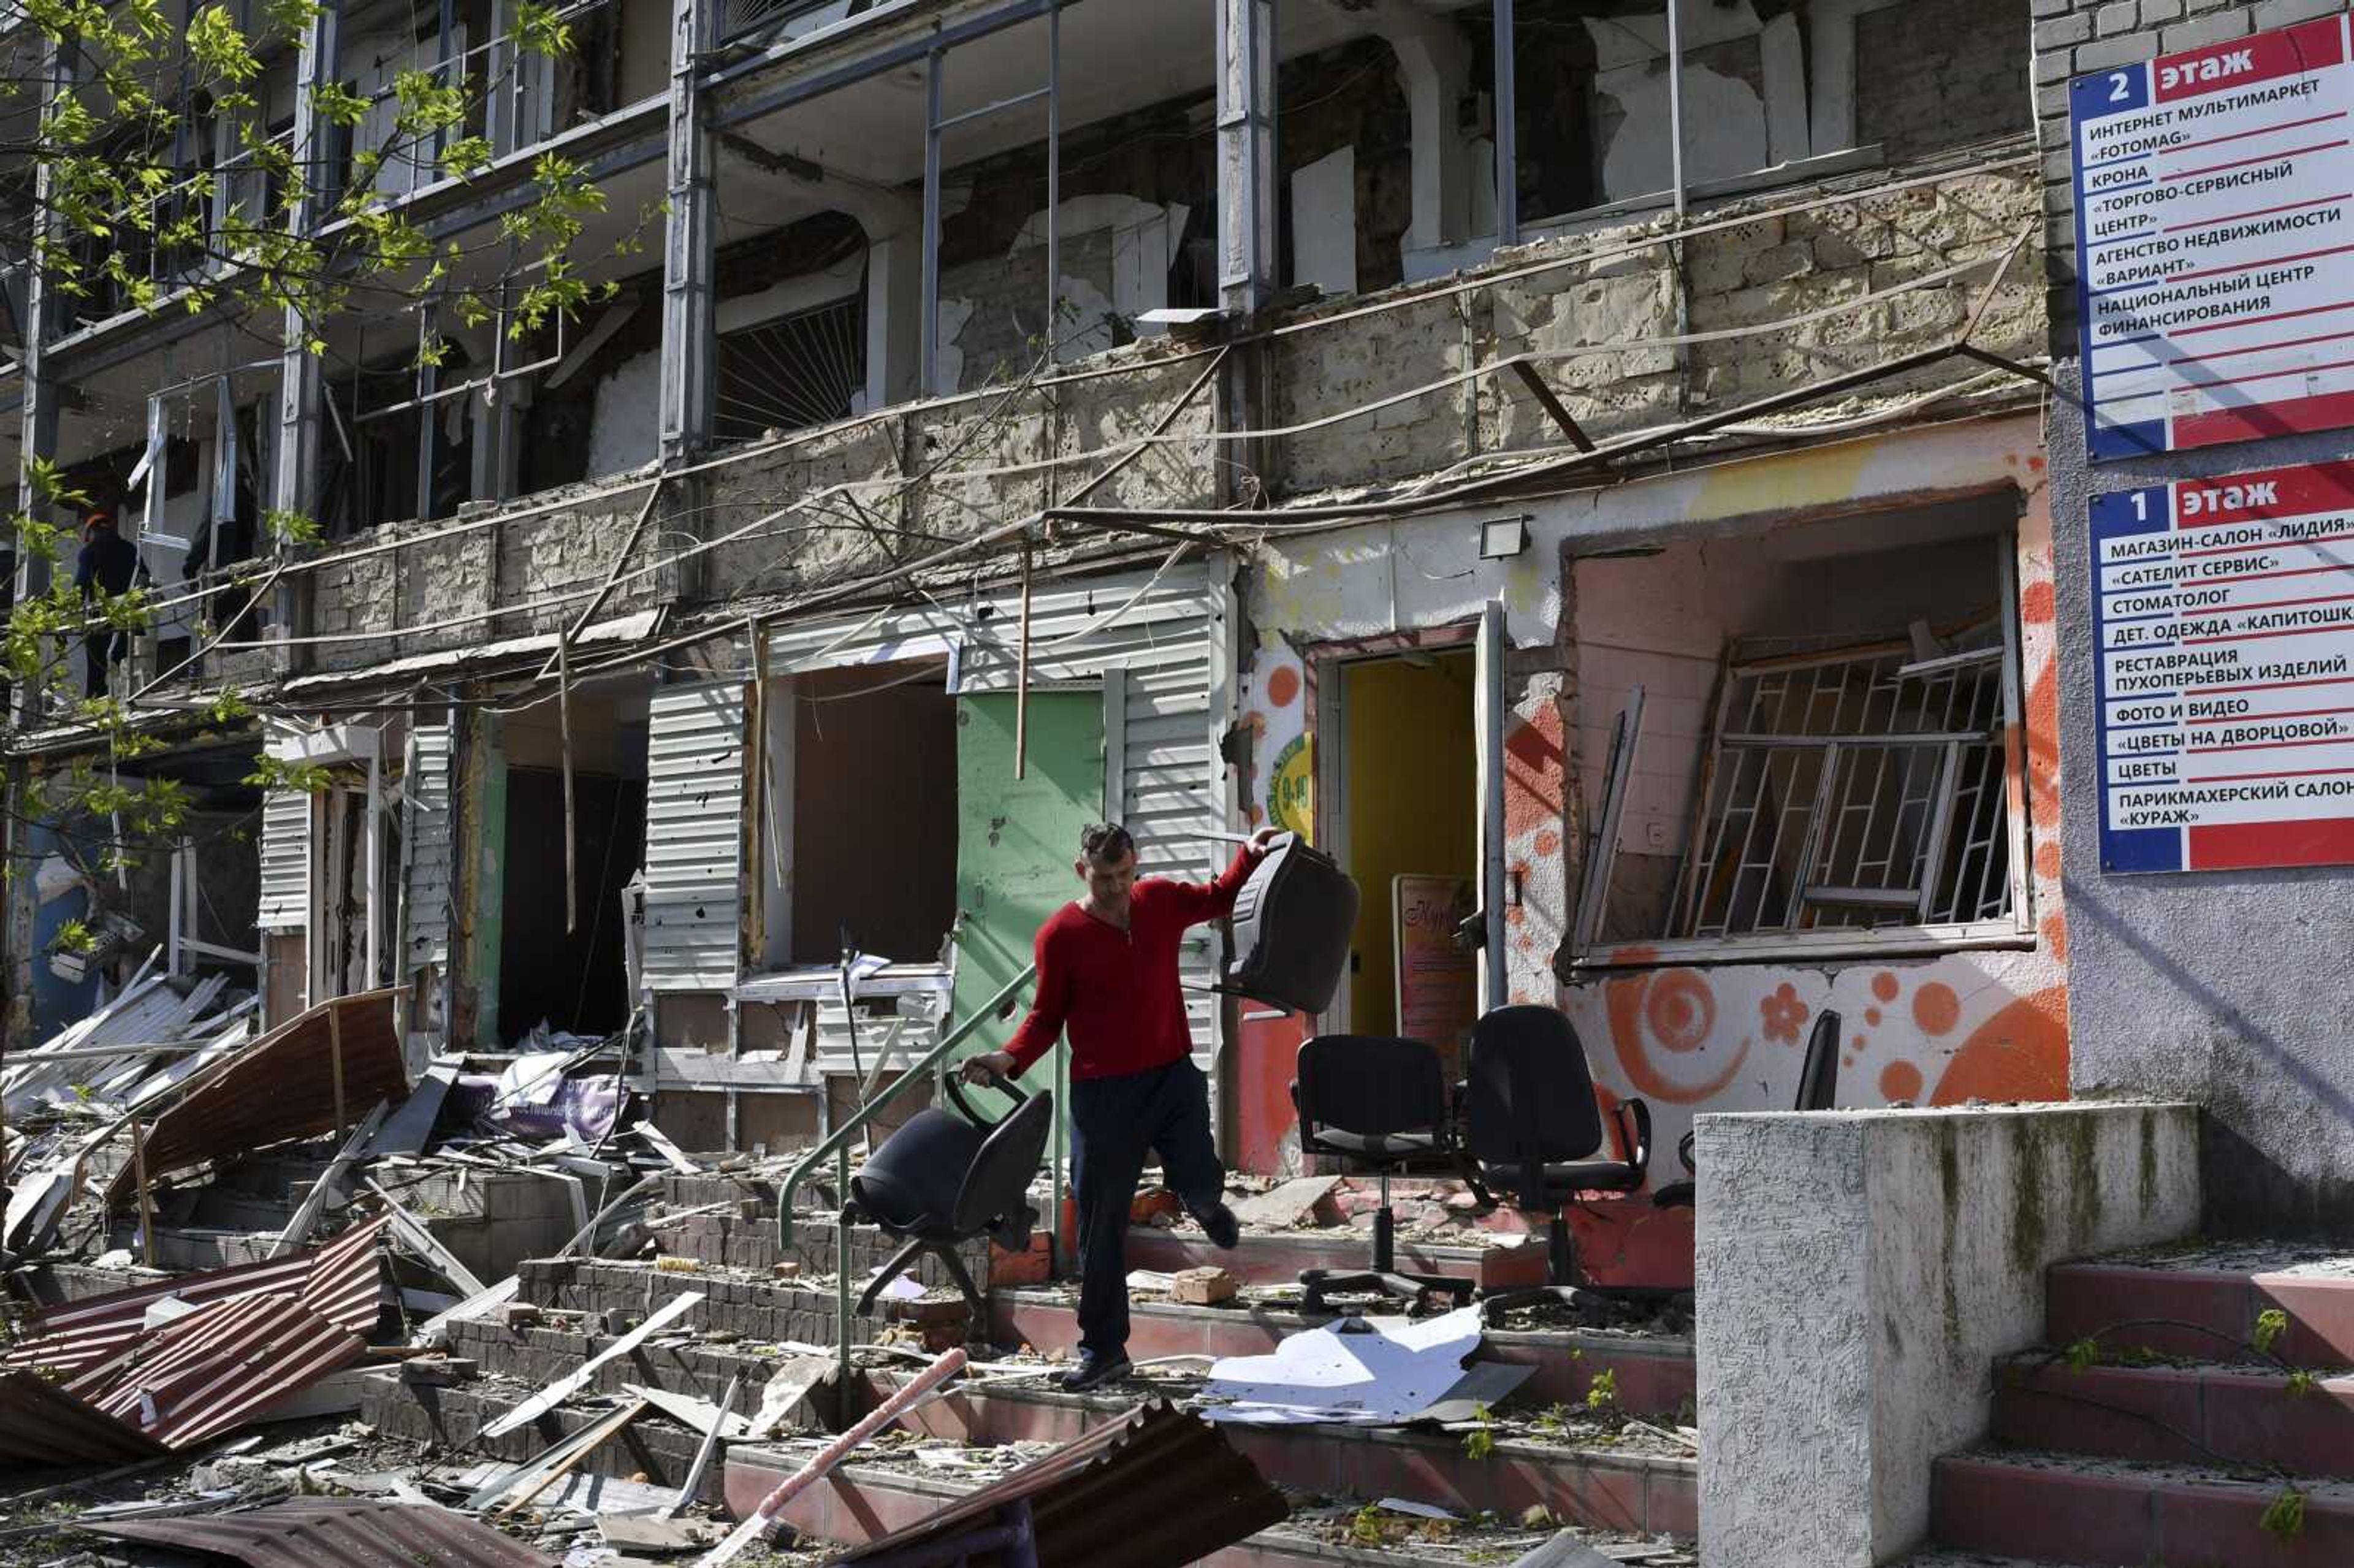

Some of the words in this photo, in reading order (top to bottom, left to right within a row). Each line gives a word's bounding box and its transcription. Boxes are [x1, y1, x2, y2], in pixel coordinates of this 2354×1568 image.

[2109, 72, 2130, 102] 2
[2161, 48, 2255, 91] этаж
[2090, 112, 2173, 140] ИНТЕРНЕТ
[2178, 79, 2320, 122] МУЛЬТИМАРКЕТ
[2090, 131, 2191, 161] «FOTOMAG»
[2092, 166, 2149, 188] КРОНА
[2093, 161, 2293, 213] «ТОРГОВО-СЕРВИСНЫЙ
[2095, 214, 2158, 237] ЦЕНТР»
[2096, 238, 2179, 265] АГЕНСТВО
[2185, 208, 2341, 249] НЕДВИЖИМОСТИ
[2097, 259, 2195, 286] «ВАРИАНТ»
[2098, 274, 2251, 316] НАЦИОНАЛЬНЫЙ
[2257, 266, 2315, 290] ЦЕНТР
[2099, 297, 2271, 337] ФИНАНСИРОВАНИЯ
[2130, 493, 2146, 520] 1
[2182, 481, 2279, 516] этаж
[2111, 528, 2262, 558] МАГАЗИН-САЛОН
[2269, 518, 2354, 539] «ЛИДИЯ»
[2112, 564, 2197, 585] «САТЕЛИТ
[2203, 556, 2279, 576] СЕРВИС»
[2112, 590, 2231, 614] СТОМАТОЛОГ
[2114, 628, 2148, 645] ДЕТ.
[2154, 619, 2231, 639] ОДЕЖДА
[2238, 606, 2354, 630] «КАПИТОШК
[2115, 650, 2238, 672] РЕСТАВРАЦИЯ
[2116, 666, 2253, 691] ПУХОПЕРЬЕВЫХ
[2258, 655, 2347, 679] ИЗДЕЛИЙ
[2117, 706, 2165, 722] ФОТО
[2171, 705, 2183, 718] И
[2189, 699, 2249, 717] ВИДЕО
[2118, 733, 2184, 752] «ЦВЕТЫ
[2192, 731, 2215, 745] НА
[2222, 718, 2348, 745] ДВОРЦОВОЙ»
[2119, 763, 2176, 779] ЦВЕТЫ
[2120, 781, 2289, 808] ПАРИКМАХЕРСКИЙ
[2120, 810, 2200, 826] «КУРАЖ»
